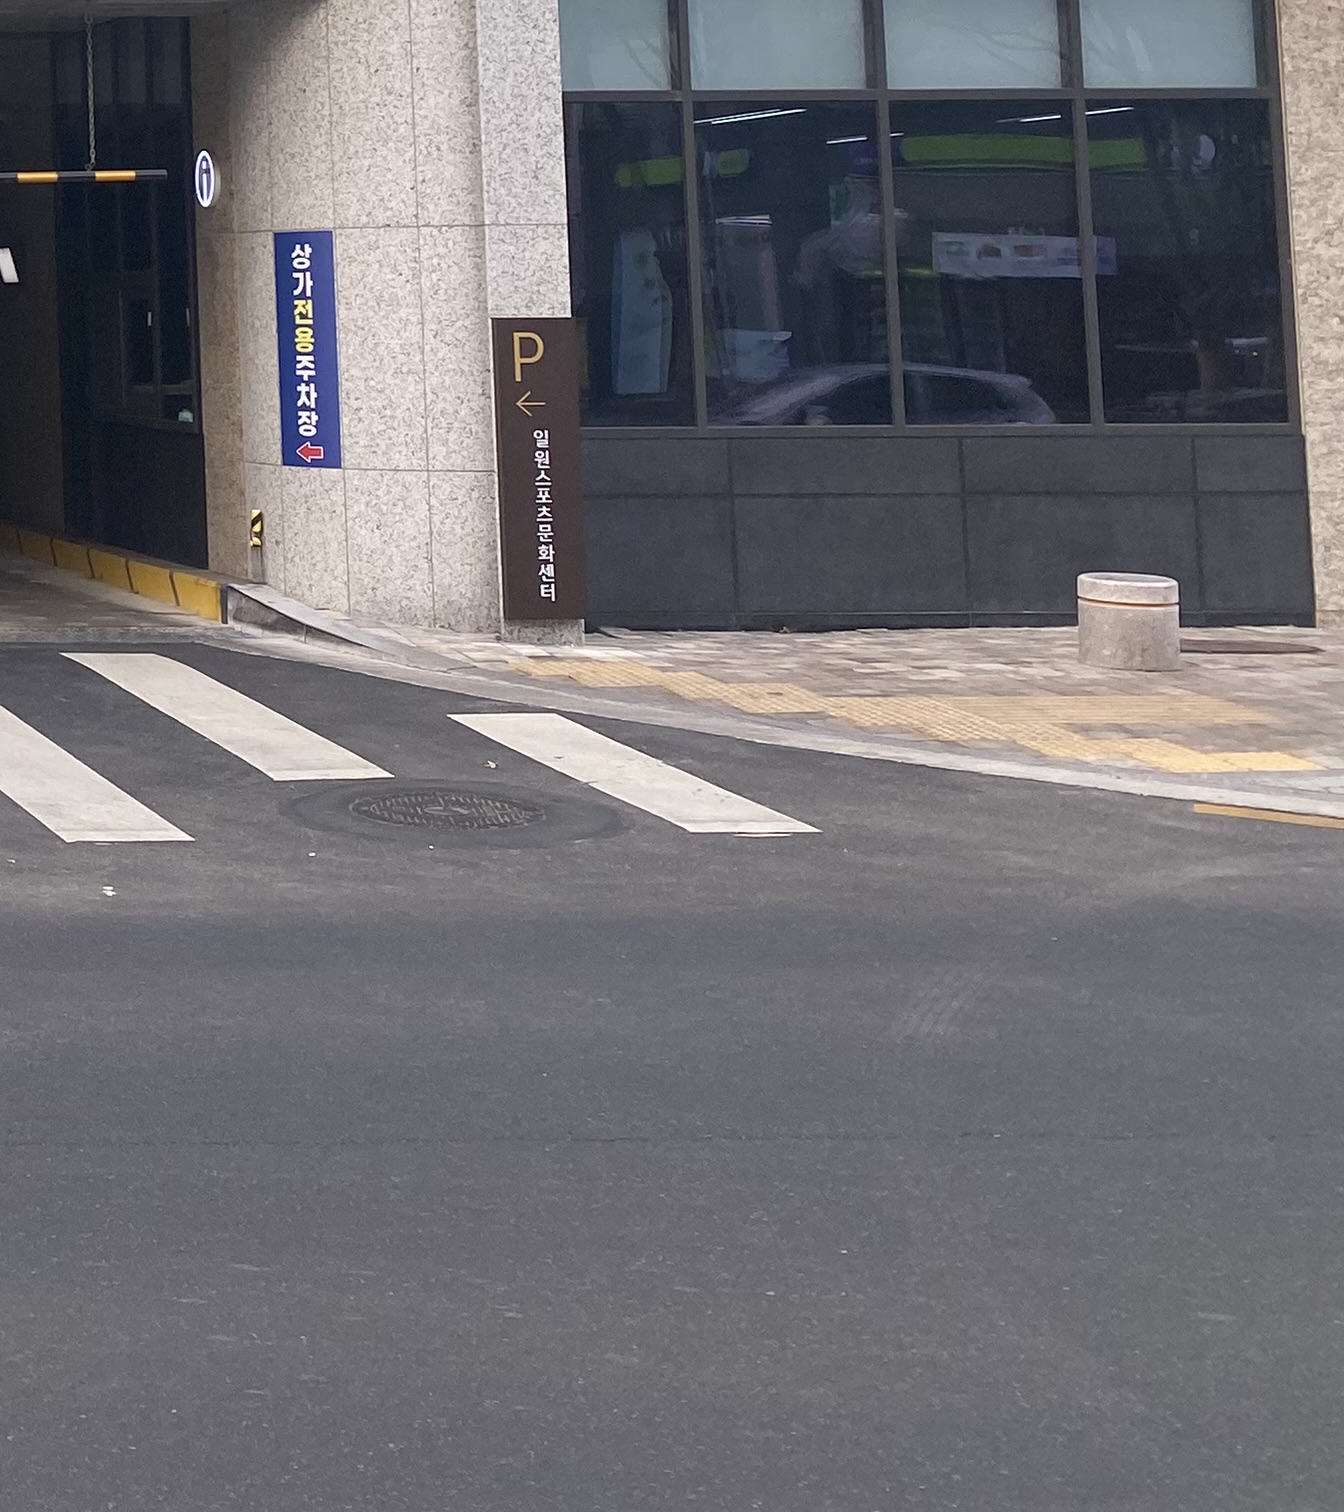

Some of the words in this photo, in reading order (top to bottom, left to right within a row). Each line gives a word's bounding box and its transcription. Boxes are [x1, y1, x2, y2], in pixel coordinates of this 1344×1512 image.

[291, 243, 319, 438] 상가전용주차장
[512, 331, 545, 383] P
[533, 429, 557, 603] 일원스포츠문화센터
